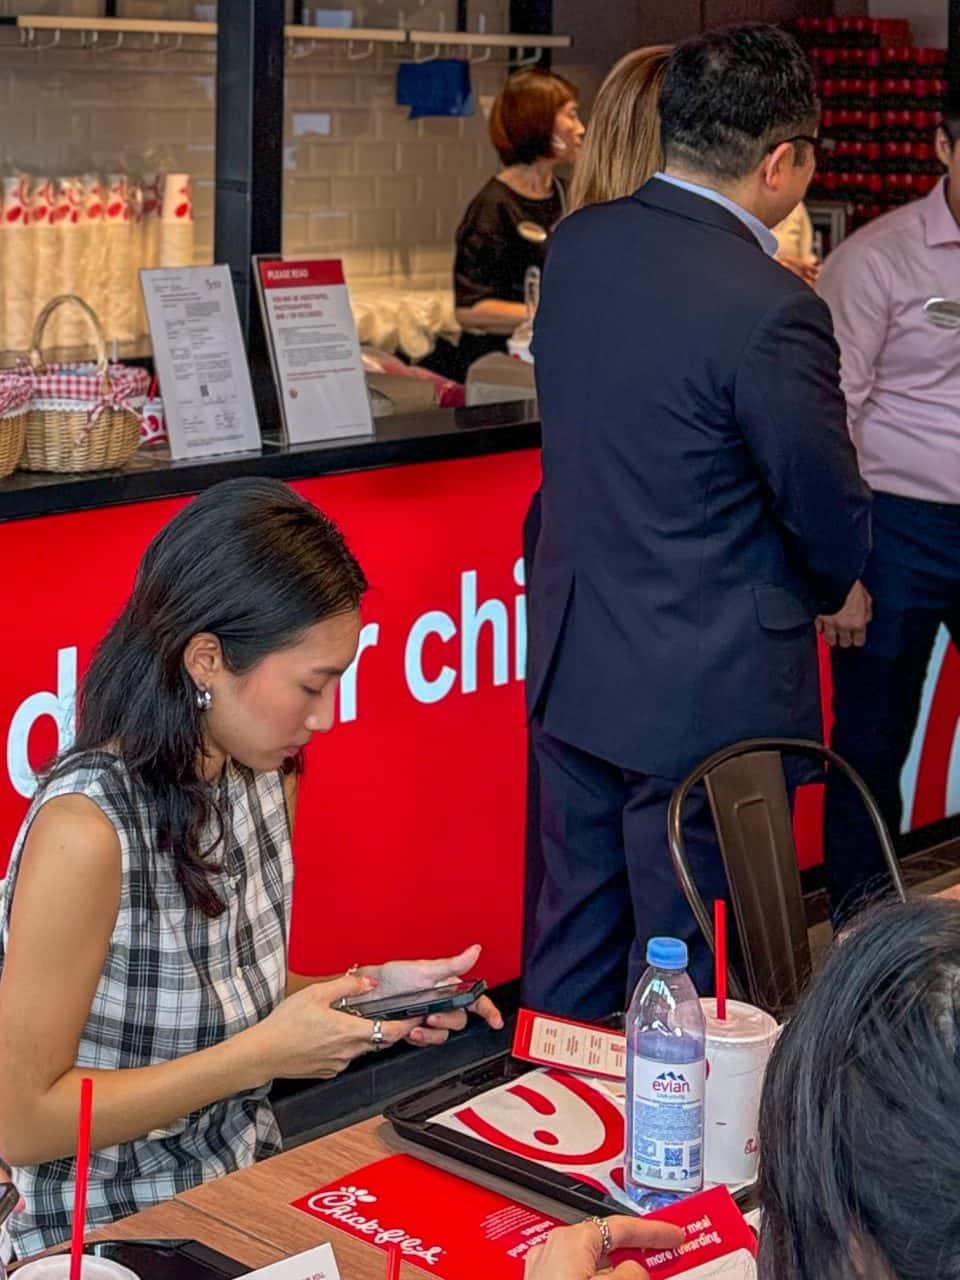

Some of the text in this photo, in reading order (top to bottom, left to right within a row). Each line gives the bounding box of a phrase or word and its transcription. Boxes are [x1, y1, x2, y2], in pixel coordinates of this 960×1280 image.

[652, 1080, 690, 1093] evian
[687, 1215, 713, 1234] meal
[645, 1250, 673, 1268] more
